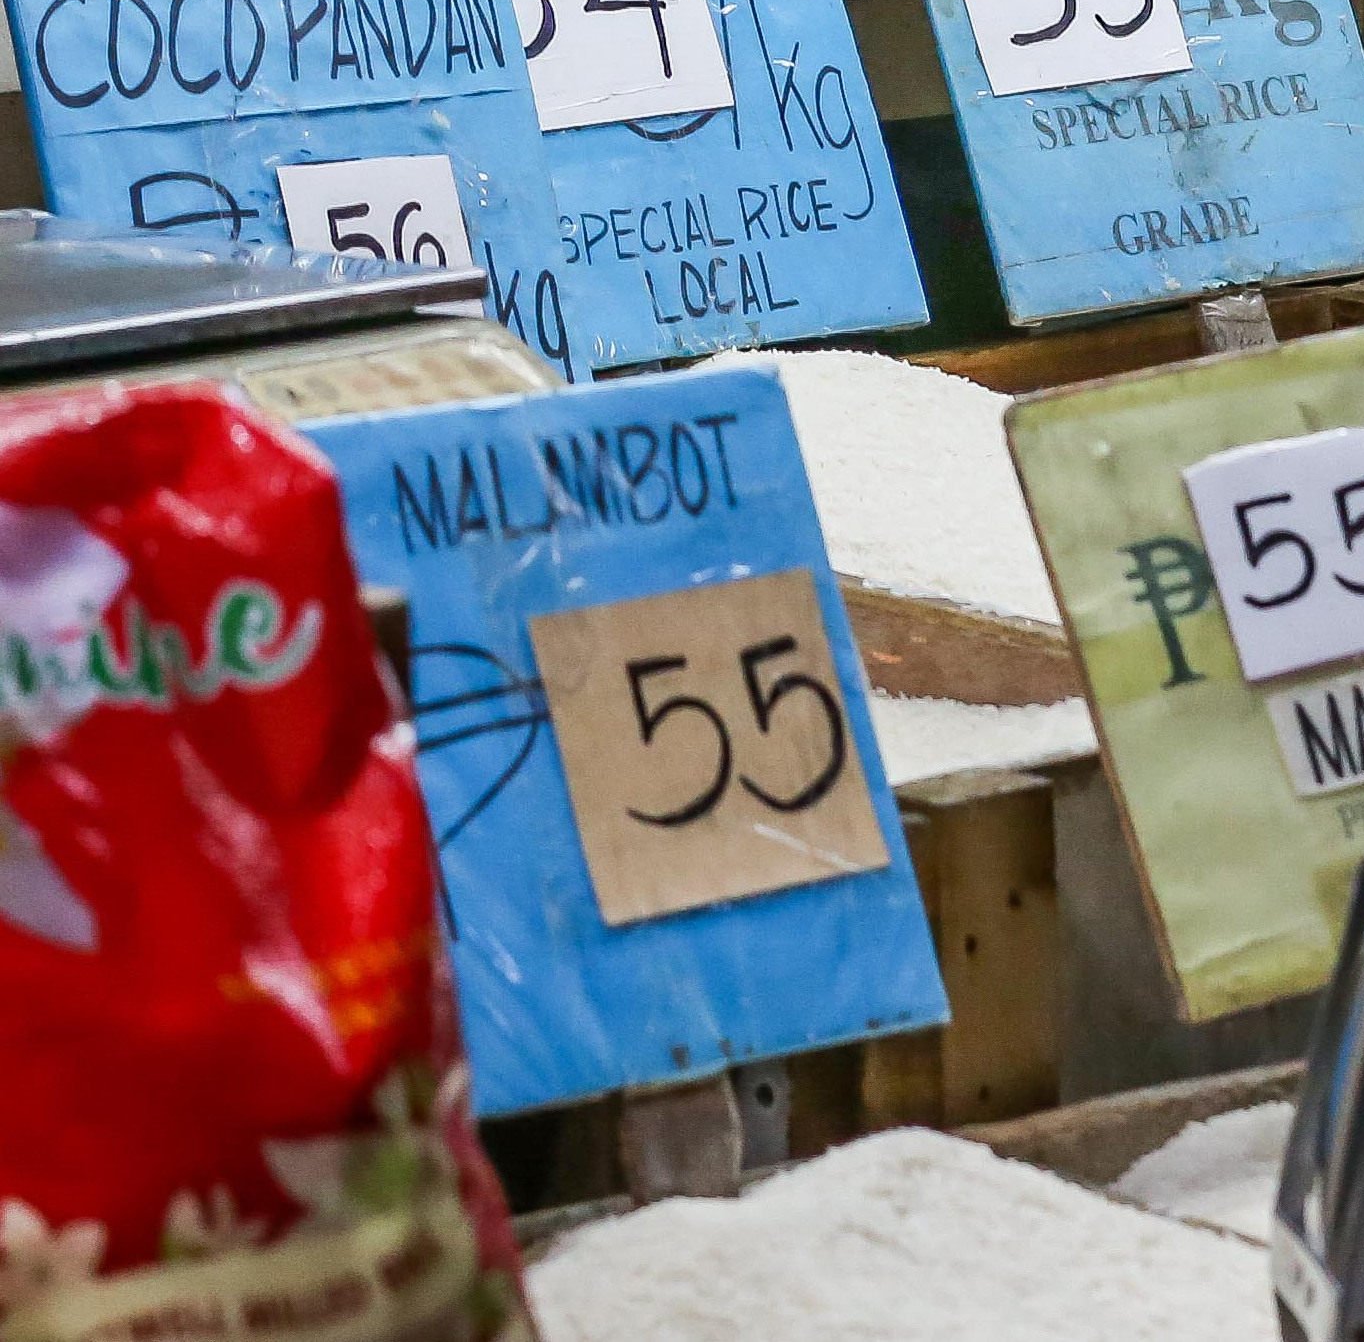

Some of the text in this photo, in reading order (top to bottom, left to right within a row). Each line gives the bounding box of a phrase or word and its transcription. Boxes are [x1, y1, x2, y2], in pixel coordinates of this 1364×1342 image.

[1030, 72, 1320, 152] SPECIAL RICE
[562, 177, 839, 266] SPECIAL RICE
[1111, 196, 1261, 256] GRADE
[645, 252, 799, 326] LOCAL
[393, 410, 741, 557] MALAMBOT
